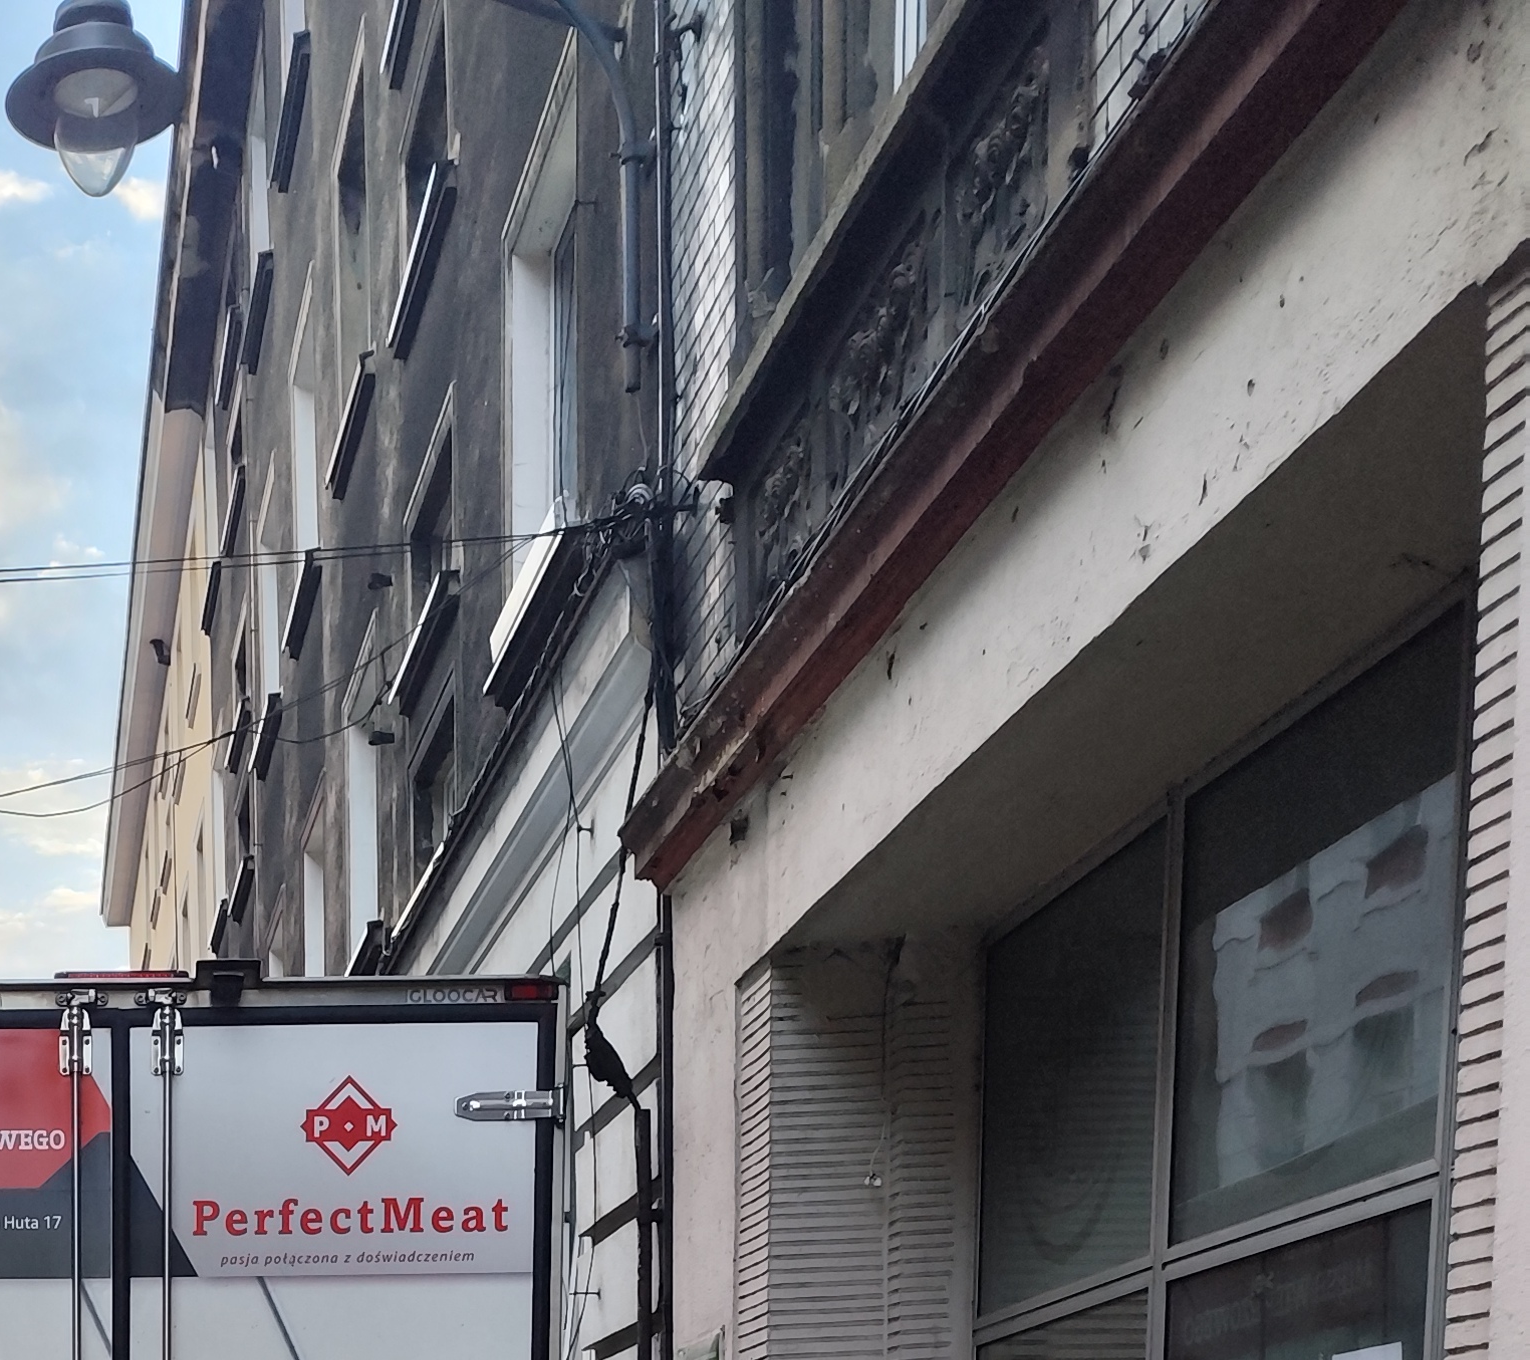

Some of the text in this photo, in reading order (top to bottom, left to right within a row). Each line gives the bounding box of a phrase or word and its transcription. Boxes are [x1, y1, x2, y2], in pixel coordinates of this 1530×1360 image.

[313, 1114, 387, 1138] P M
[4, 1215, 39, 1230] Huta
[43, 1215, 62, 1230] 17
[192, 1197, 509, 1236] PerfectMeat
[220, 1250, 475, 1268] pasja połączona z doświadczeniem
